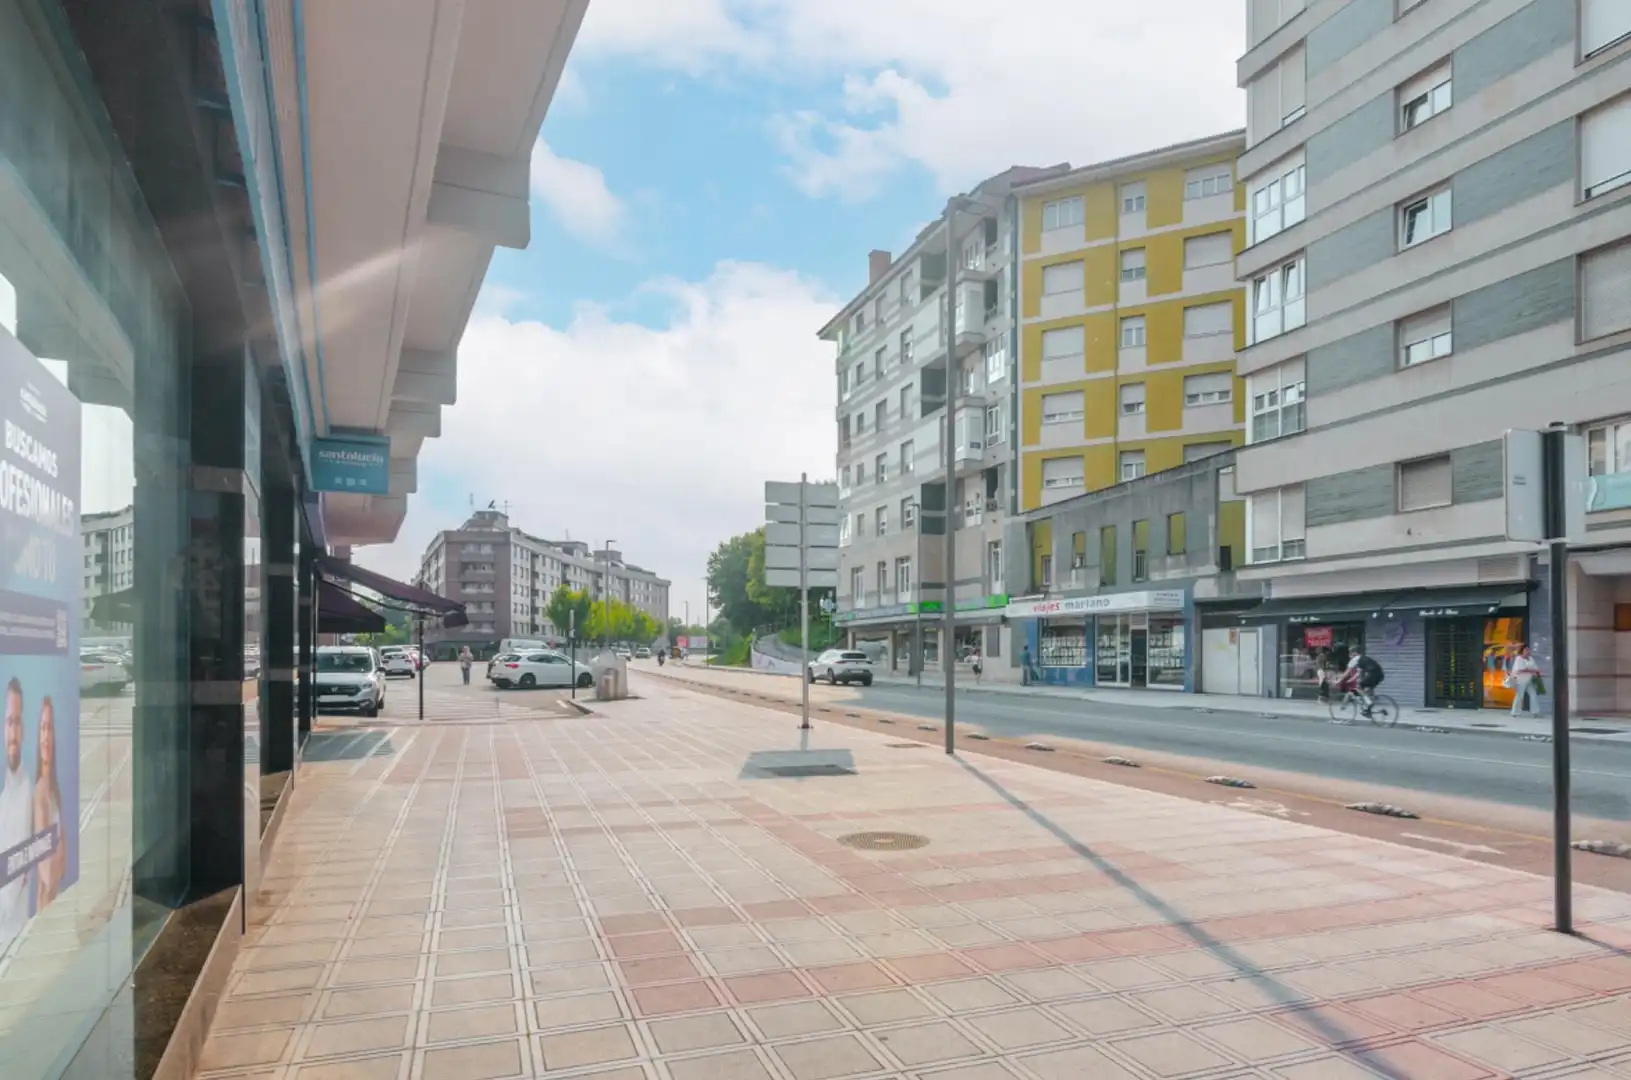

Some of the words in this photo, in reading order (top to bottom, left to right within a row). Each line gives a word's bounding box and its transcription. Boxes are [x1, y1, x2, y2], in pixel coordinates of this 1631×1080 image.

[5, 419, 58, 478] BUSCAMOS
[1033, 601, 1060, 614] viajes
[1065, 599, 1110, 612] mariano
